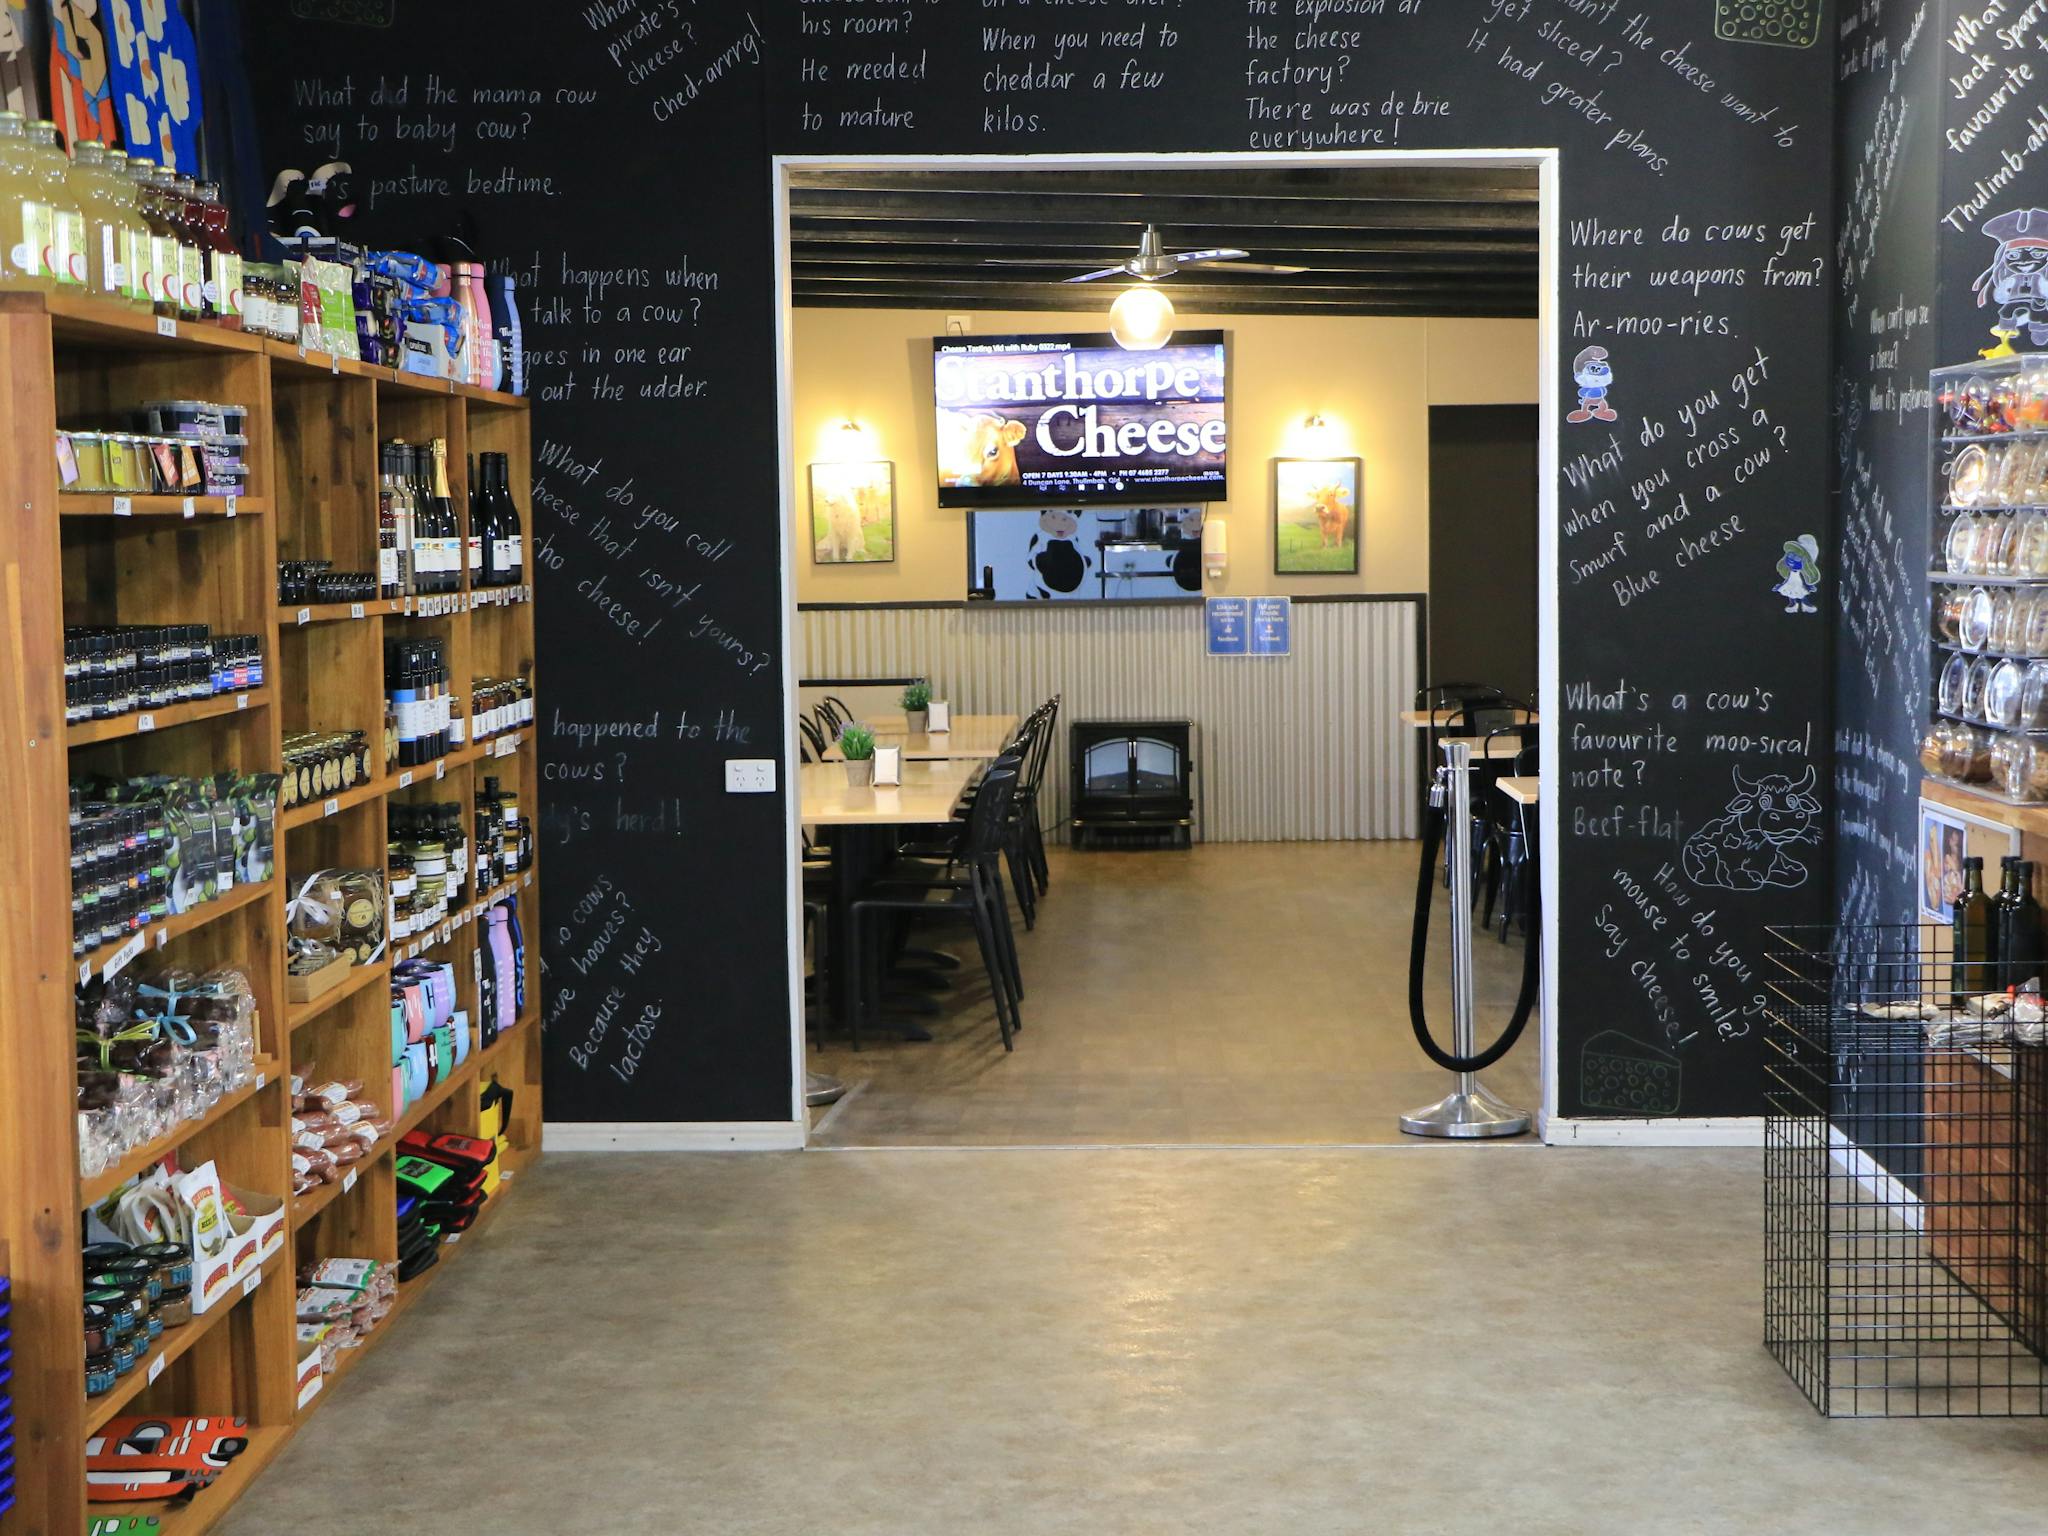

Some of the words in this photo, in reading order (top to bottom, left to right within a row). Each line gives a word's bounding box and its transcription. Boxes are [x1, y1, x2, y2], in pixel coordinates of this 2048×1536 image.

[607, 1, 679, 67] pirate's
[802, 11, 831, 35] his
[843, 10, 913, 35] room?
[982, 27, 1037, 52] When
[1054, 34, 1088, 61] you
[1099, 22, 1145, 49] need
[1158, 23, 1179, 47] to
[1246, 28, 1278, 50] the
[1294, 27, 1361, 50] cheese
[628, 22, 699, 85] cheese?
[801, 57, 829, 82] He
[846, 49, 927, 81] needed
[1538, 19, 1623, 76] sliced?
[294, 75, 355, 107] What
[370, 76, 408, 105] did
[425, 74, 458, 104] the
[473, 88, 542, 104] mama
[555, 89, 598, 104] cow
[983, 63, 1076, 92] cheddar
[1093, 72, 1106, 90] a
[1119, 59, 1164, 89] few
[1245, 55, 1351, 94] factory?
[1621, 13, 1654, 51] the
[1659, 41, 1716, 93] cheese
[1720, 93, 1779, 124] want
[1773, 125, 1798, 148] to
[1949, 53, 1997, 100] Jack
[801, 101, 823, 130] to
[839, 97, 915, 129] mature
[983, 104, 1048, 134] kilos.
[1246, 97, 1313, 121] There
[1329, 100, 1371, 118] was
[1467, 28, 1487, 53] It
[1497, 46, 1544, 82] had
[1541, 81, 1612, 126] grater
[1604, 128, 1669, 177] plans.
[1945, 63, 2035, 153] favourite
[303, 122, 341, 159] say
[357, 114, 379, 141] to
[396, 115, 456, 153] baby
[476, 112, 533, 141] cow?
[1249, 117, 1401, 150] everywhere!
[370, 165, 450, 210] pasture
[467, 167, 563, 196] bedtime.
[1570, 216, 1645, 247] Where
[1661, 214, 1691, 243] do
[1704, 224, 1767, 243] cows
[1775, 211, 1817, 257] get
[562, 251, 650, 302] happens
[665, 254, 719, 291] when
[1572, 262, 1632, 289] their
[1649, 268, 1746, 297] weapons
[1763, 256, 1824, 287] from?
[531, 296, 573, 324] talk
[583, 295, 602, 325] to
[616, 306, 632, 323] a
[642, 297, 701, 327] cow?
[582, 341, 601, 364] in
[614, 348, 647, 364] one
[658, 345, 693, 365] ear
[541, 371, 577, 402] out
[591, 374, 625, 402] the
[639, 373, 708, 399] udder.
[1035, 405, 1226, 458] Cheese
[1562, 433, 1625, 492] What
[1640, 416, 1666, 448] do
[1677, 389, 1721, 438] you
[1731, 346, 1770, 410] get
[1022, 471, 1041, 479] OPEN
[1047, 471, 1063, 479] DAYS
[1564, 498, 1618, 538] when
[1631, 467, 1671, 512] you
[1686, 425, 1741, 469] cross
[1752, 408, 1769, 428] a
[538, 439, 603, 486] What
[605, 478, 635, 507] do
[633, 503, 681, 533] you
[685, 532, 736, 563] call
[1568, 531, 1628, 585] Smurf
[1646, 492, 1691, 540] and
[1705, 484, 1722, 502] a
[1734, 424, 1790, 484] cow?
[531, 477, 582, 527] heese
[587, 515, 638, 560] that
[639, 566, 703, 609] isn't
[689, 612, 771, 678] yours?
[1612, 569, 1661, 608] Blue
[1675, 514, 1746, 569] cheese
[576, 574, 663, 647] cheese!
[1565, 678, 1649, 713] What's
[1671, 694, 1688, 711] a
[1705, 686, 1774, 712] cow's
[552, 708, 659, 749] happened
[675, 710, 701, 740] to
[714, 709, 751, 744] the
[1571, 722, 1679, 754] favourite
[1705, 720, 1812, 758] moo-sical
[543, 751, 628, 783] cows?
[1571, 757, 1647, 788] note?
[615, 796, 681, 836] herd!
[1573, 805, 1685, 848] Beef-flat
[572, 873, 614, 925] cows
[570, 890, 637, 977] hooves?
[1594, 903, 1629, 959] Say
[1652, 861, 1691, 908] How
[1691, 909, 1717, 937] do
[1708, 941, 1753, 984] you
[1612, 868, 1668, 931] mouse
[1669, 932, 1691, 961] to
[1692, 972, 1750, 1043] smile?
[568, 985, 627, 1072] Because
[619, 926, 663, 977] they
[609, 998, 663, 1084] lactose.
